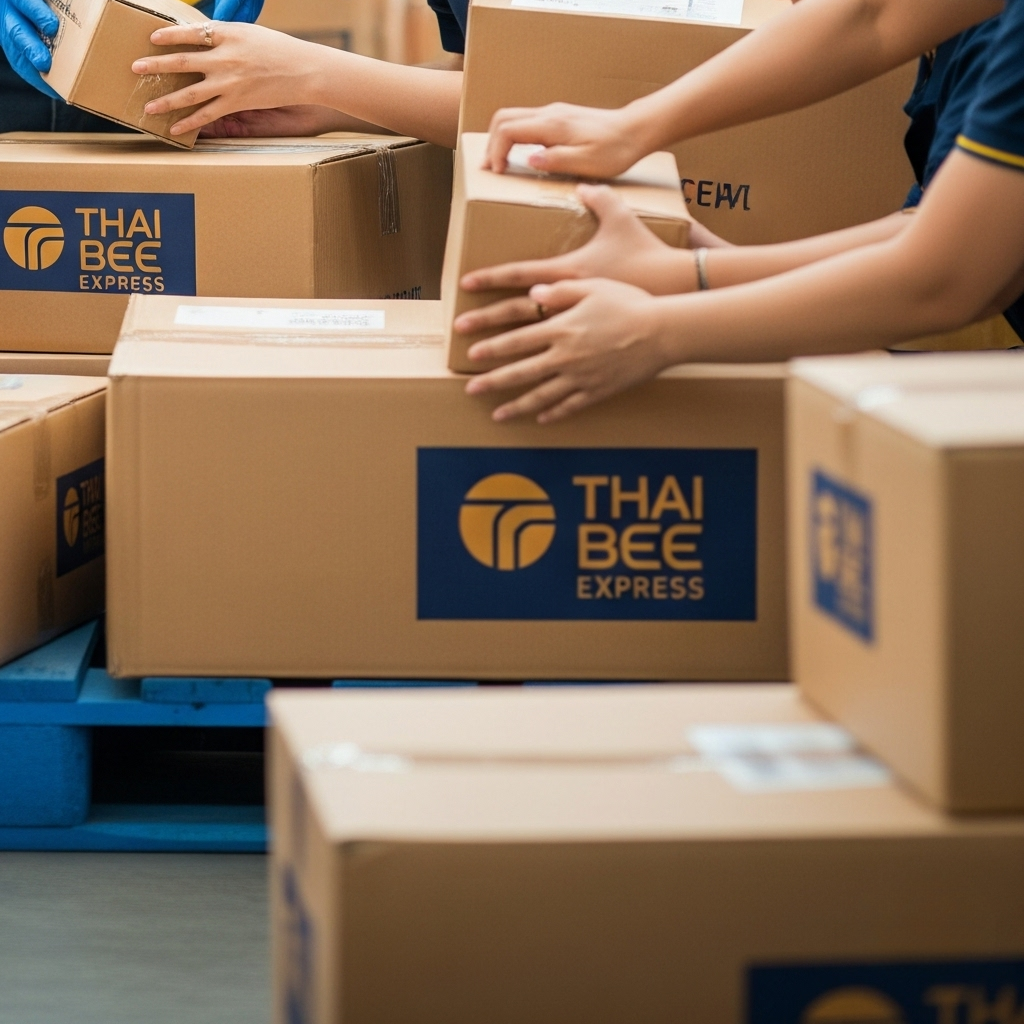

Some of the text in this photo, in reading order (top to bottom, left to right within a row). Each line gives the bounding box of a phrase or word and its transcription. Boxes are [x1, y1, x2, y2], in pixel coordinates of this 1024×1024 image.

[75, 207, 161, 239] THAI
[80, 240, 162, 273] BEE
[79, 275, 165, 292] EXPRESS
[573, 475, 703, 520] THAI
[578, 523, 703, 571] BEE
[577, 575, 705, 600] EXPRESS
[922, 982, 1024, 1024] TH
